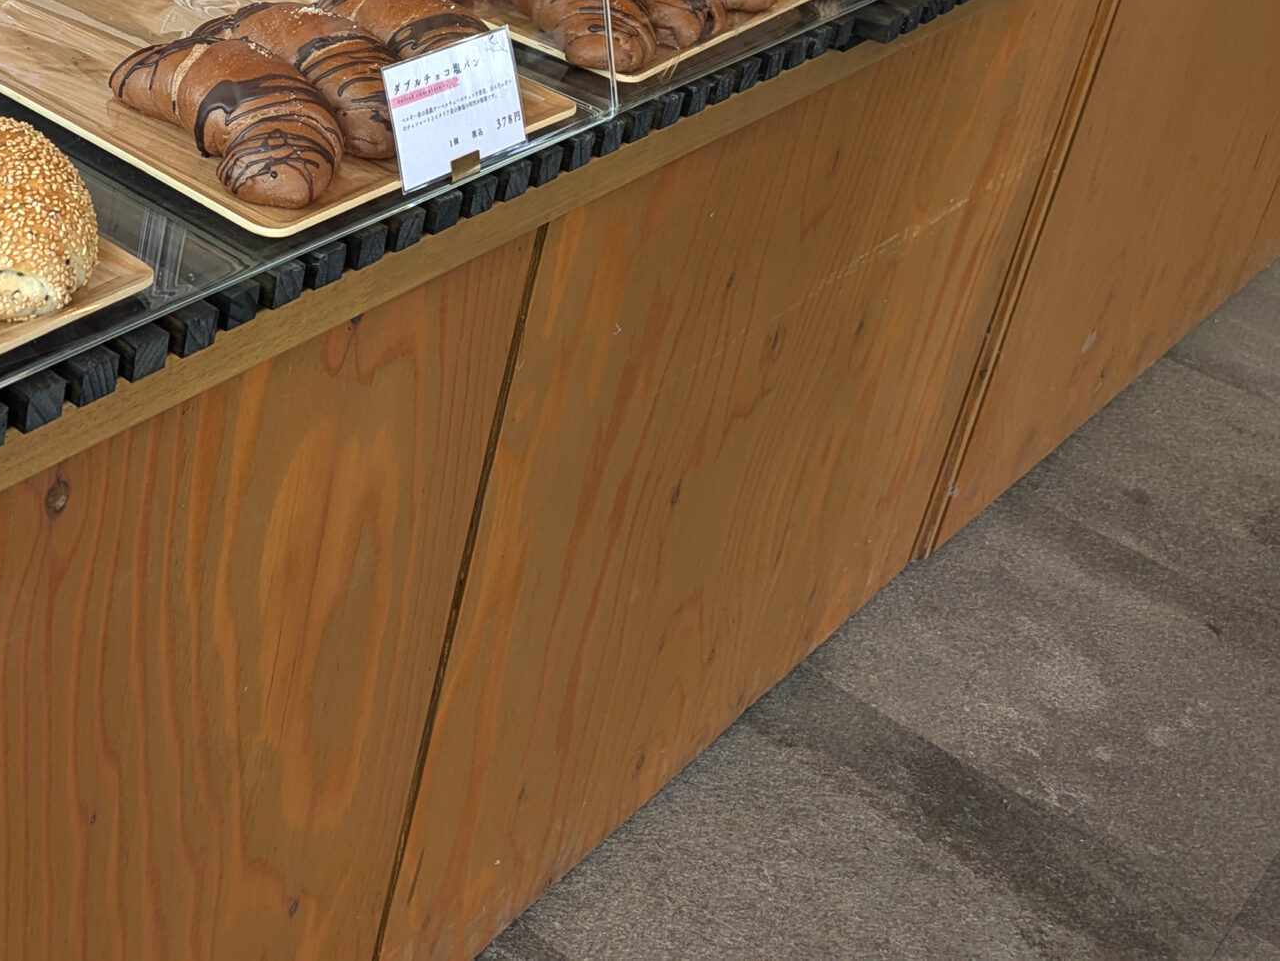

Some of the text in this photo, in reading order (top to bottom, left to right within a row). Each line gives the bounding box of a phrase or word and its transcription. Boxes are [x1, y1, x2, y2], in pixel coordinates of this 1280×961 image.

[394, 58, 480, 96] ダブルチョコ塩パン
[496, 110, 521, 130] 378円
